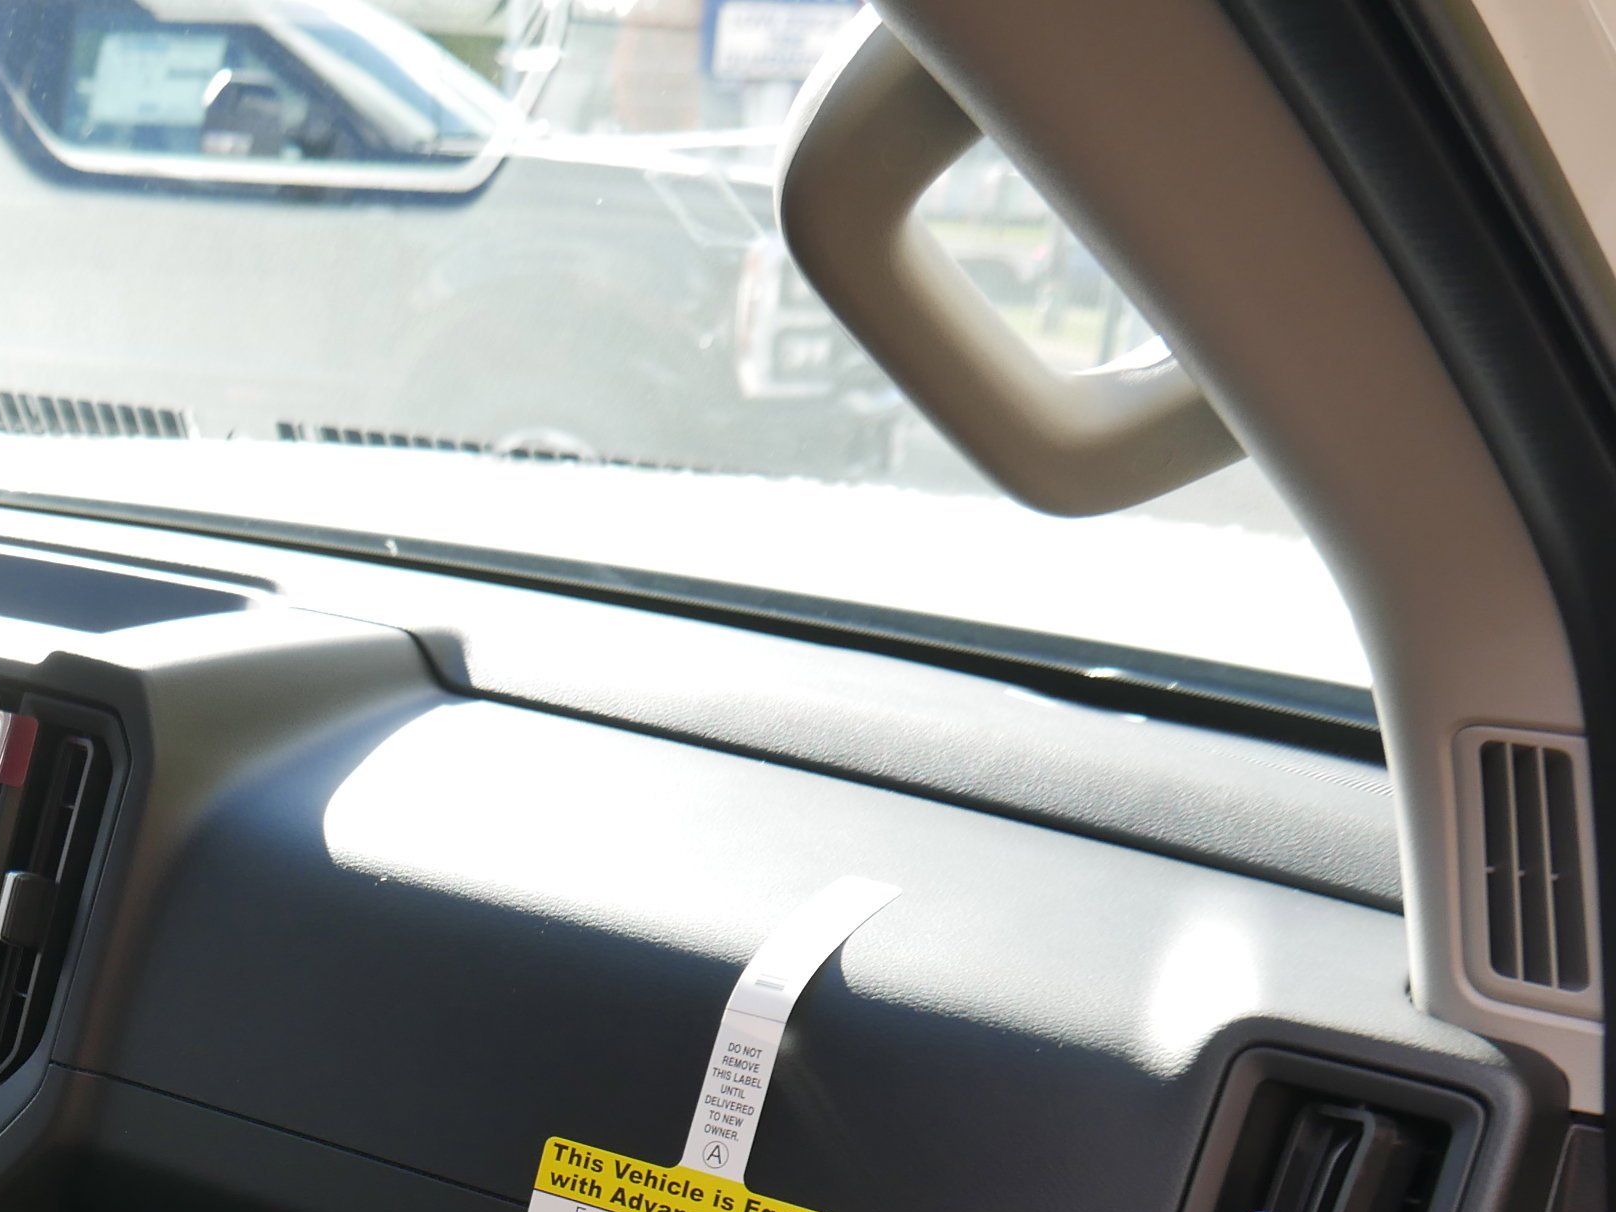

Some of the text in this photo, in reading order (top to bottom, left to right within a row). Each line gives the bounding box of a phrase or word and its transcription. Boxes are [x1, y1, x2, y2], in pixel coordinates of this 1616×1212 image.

[727, 1042, 763, 1059] DO NOT
[722, 1055, 761, 1073] REMOVE
[712, 1067, 762, 1089] THIS LABEL
[720, 1084, 746, 1099] UNTIL
[704, 1094, 755, 1116] DELIVERED
[709, 1109, 745, 1128] TO NEW
[703, 1123, 739, 1142] OWNER.
[706, 1144, 722, 1165] A
[550, 1171, 602, 1200] with
[553, 1142, 604, 1173] This
[614, 1159, 704, 1203] Vehicle
[712, 1189, 735, 1212] is
